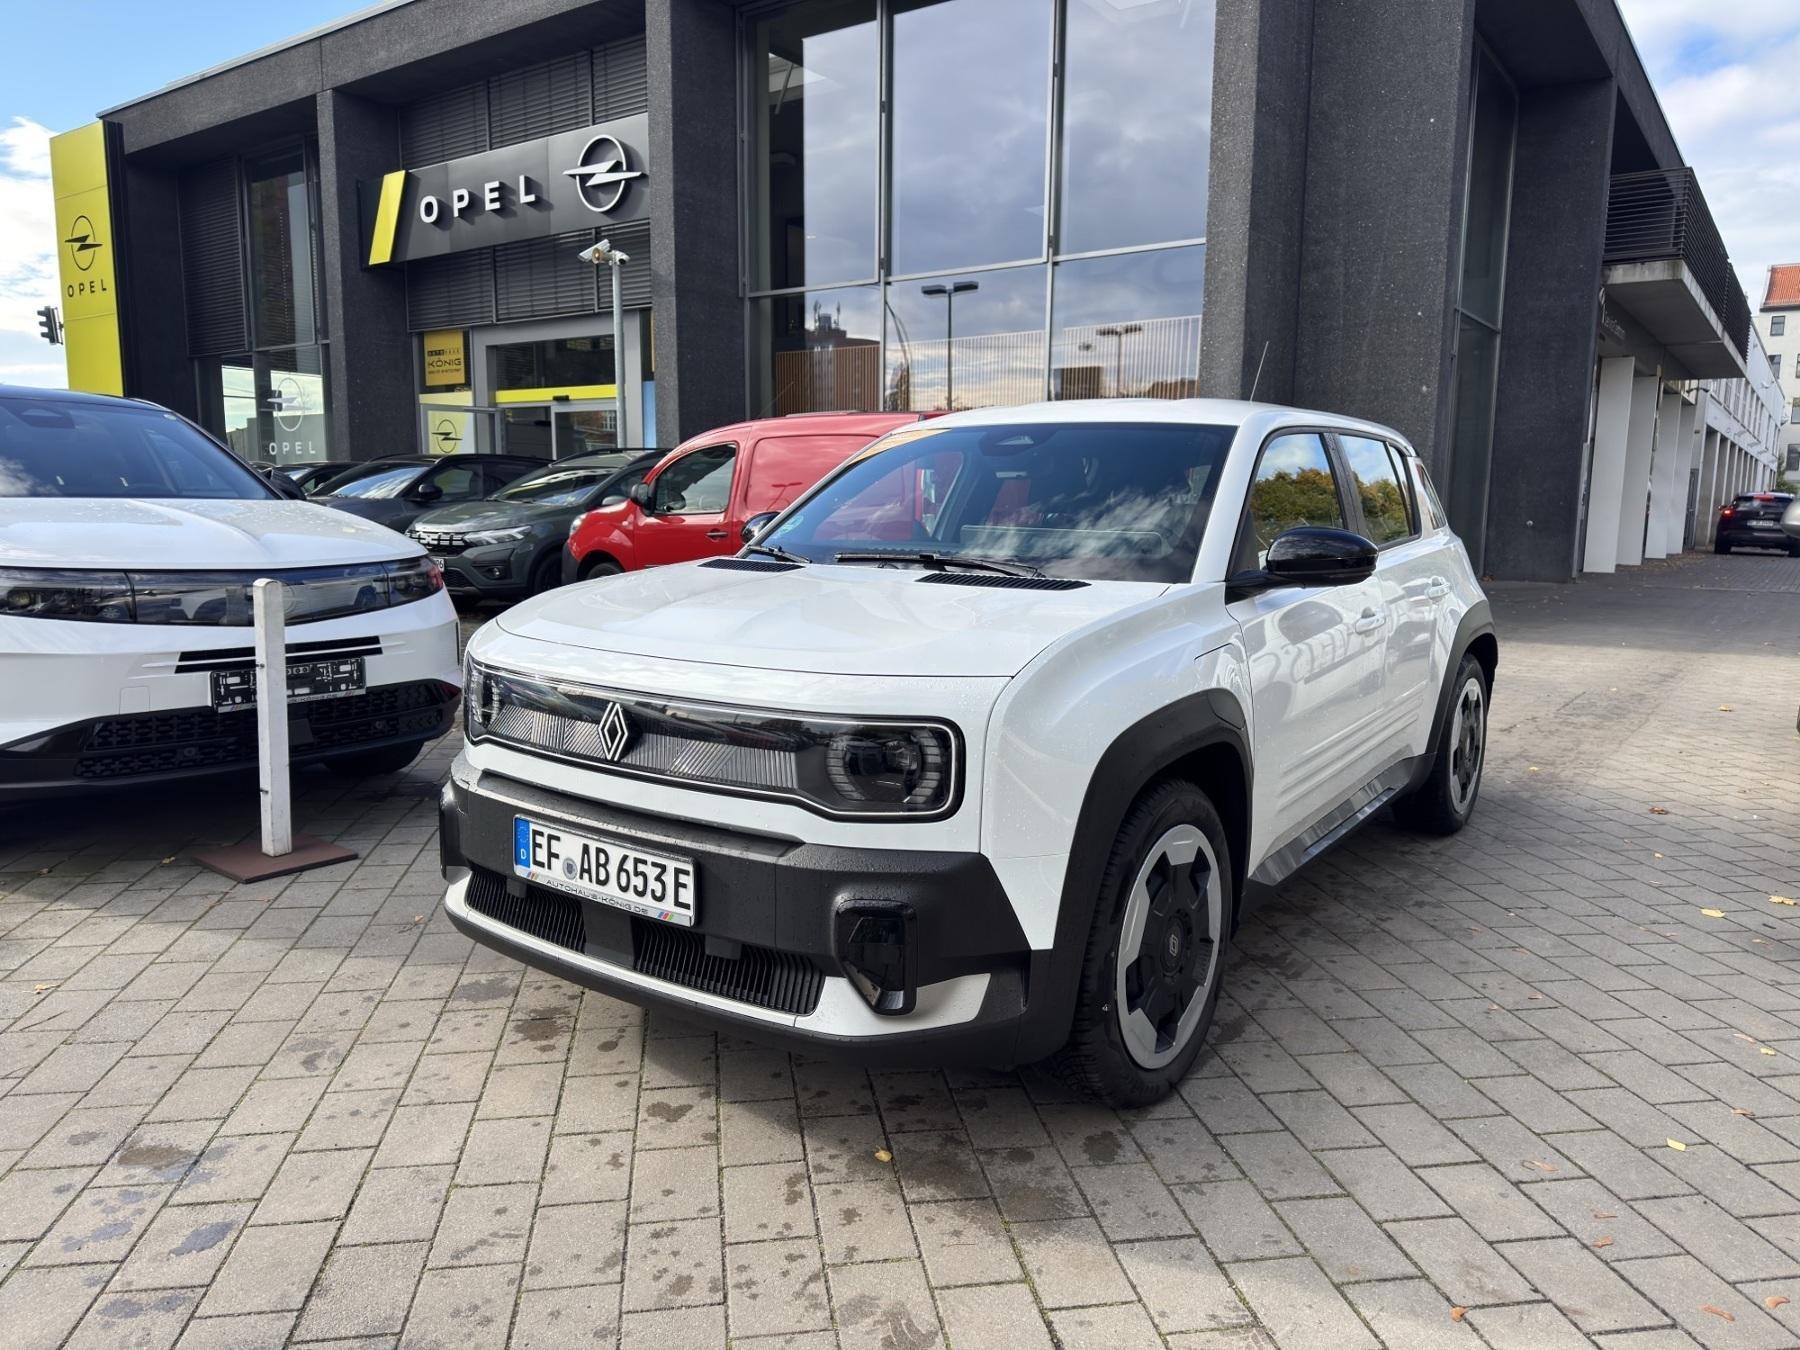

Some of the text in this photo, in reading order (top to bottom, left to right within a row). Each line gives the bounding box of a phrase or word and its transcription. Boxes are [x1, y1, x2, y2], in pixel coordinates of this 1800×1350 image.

[420, 175, 536, 223] OPEL
[67, 278, 107, 298] OPEL
[428, 357, 462, 368] KÖNIG
[269, 440, 317, 456] OPEL
[520, 848, 527, 860] D
[531, 828, 561, 871] EF
[579, 842, 610, 887] AB
